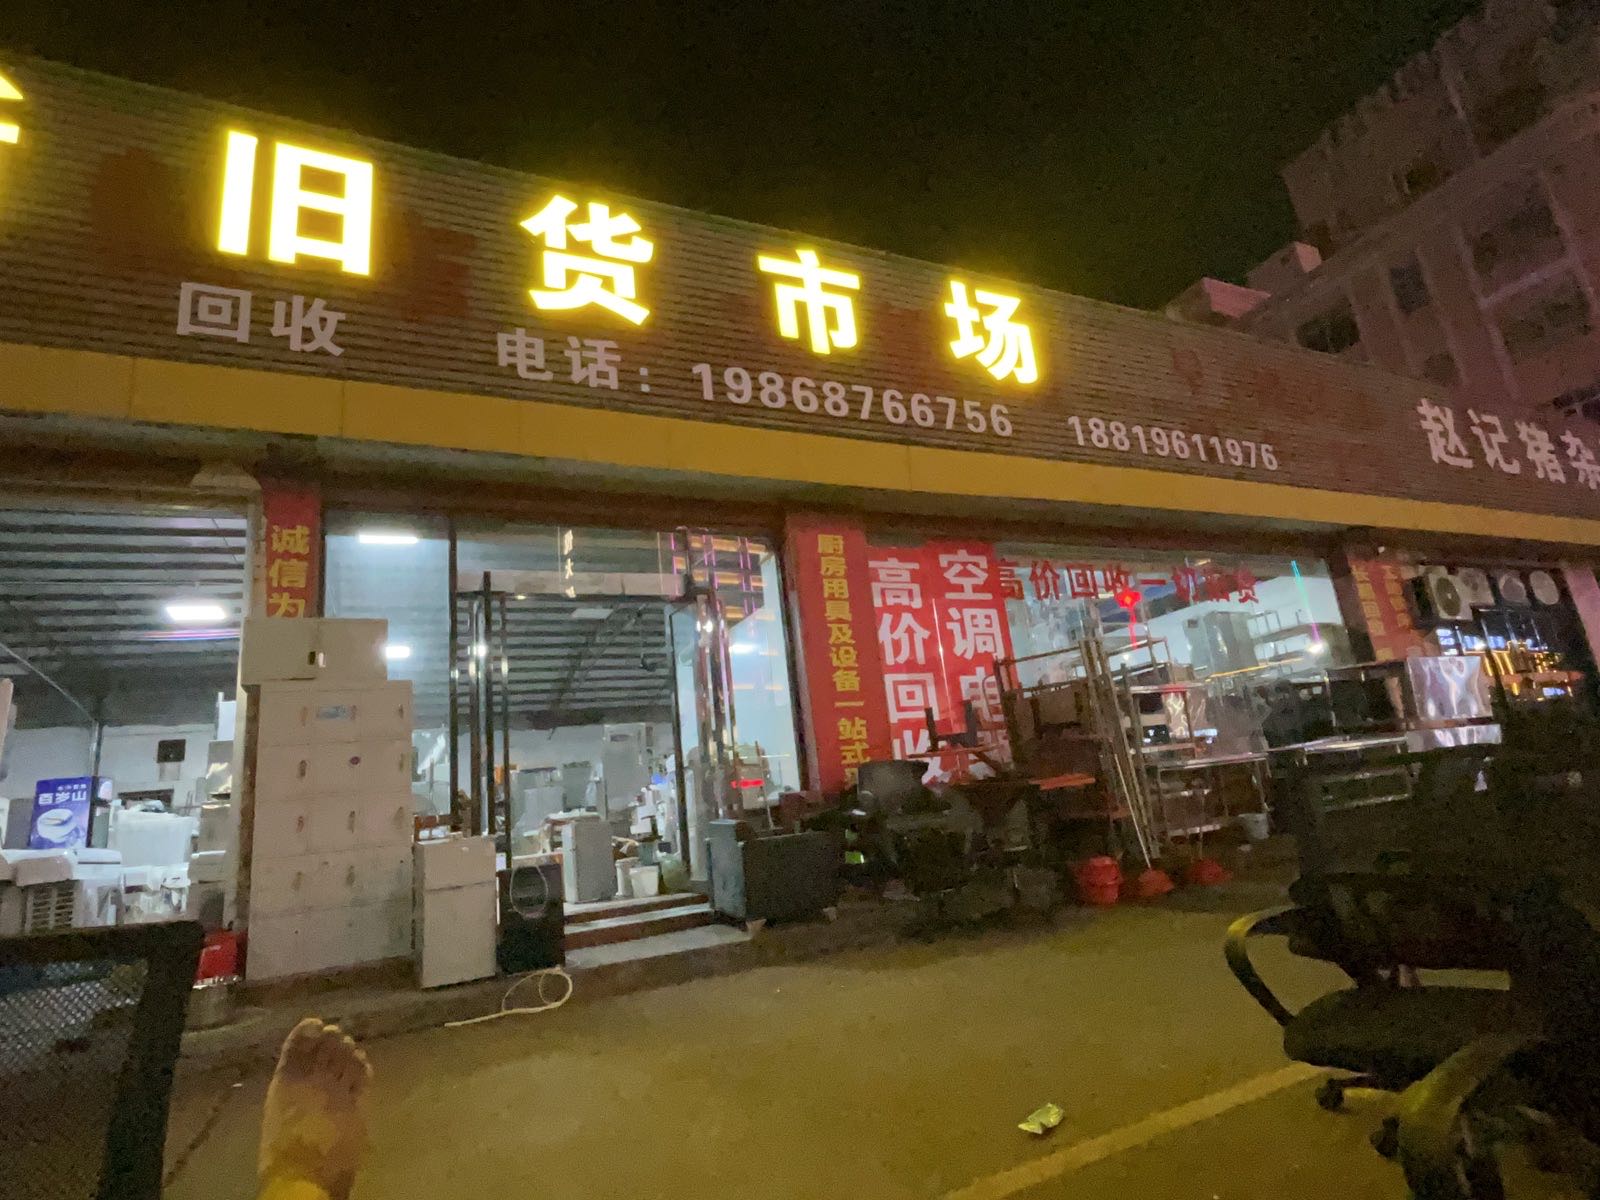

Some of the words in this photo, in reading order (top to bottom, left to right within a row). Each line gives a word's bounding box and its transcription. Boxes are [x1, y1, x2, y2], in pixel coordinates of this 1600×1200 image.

[0, 74, 1038, 385] 旧货市场
[176, 281, 346, 356] 回收
[692, 362, 1014, 437] 19868766756
[1067, 415, 1279, 471] 18819611976
[1416, 398, 1600, 490] 赵记猪杂
